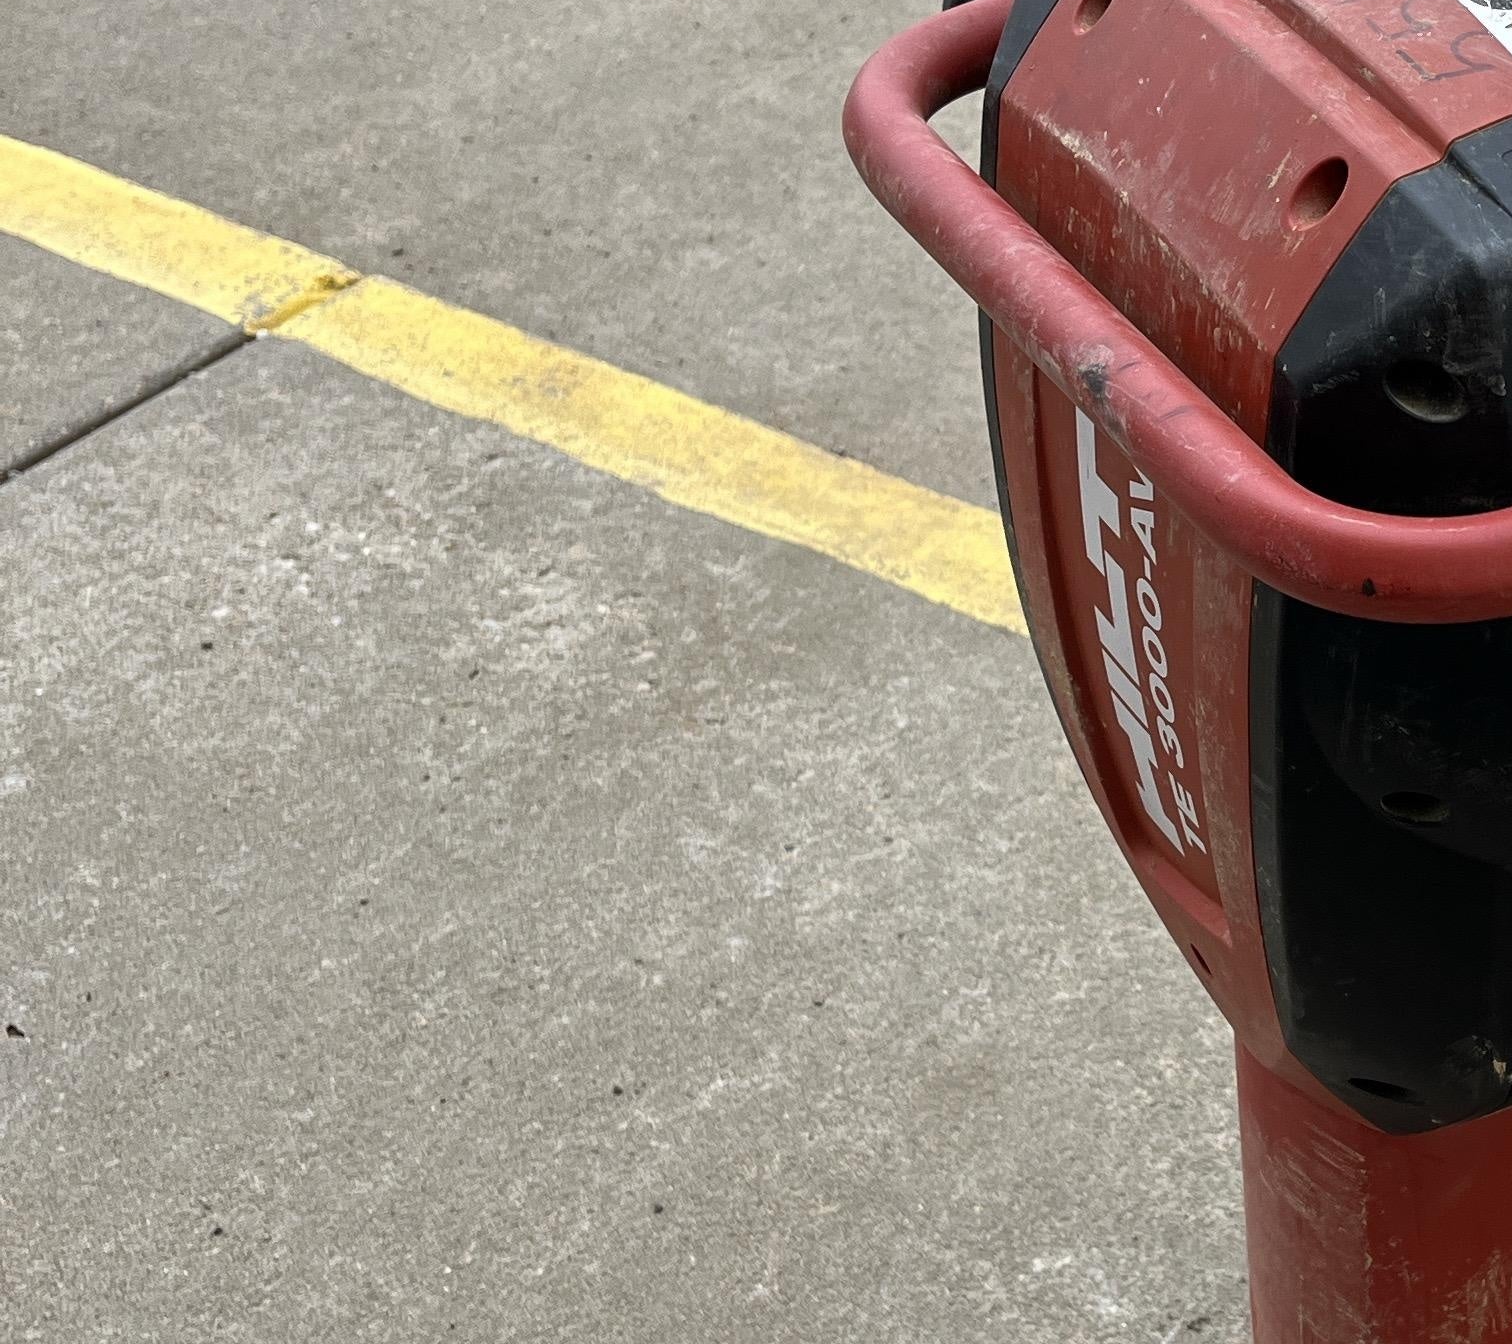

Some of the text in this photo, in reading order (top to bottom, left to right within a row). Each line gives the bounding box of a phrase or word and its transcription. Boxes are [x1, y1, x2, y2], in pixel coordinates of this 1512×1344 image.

[1074, 405, 1186, 857] HILT
[1129, 464, 1207, 855] TE 3000-AV
